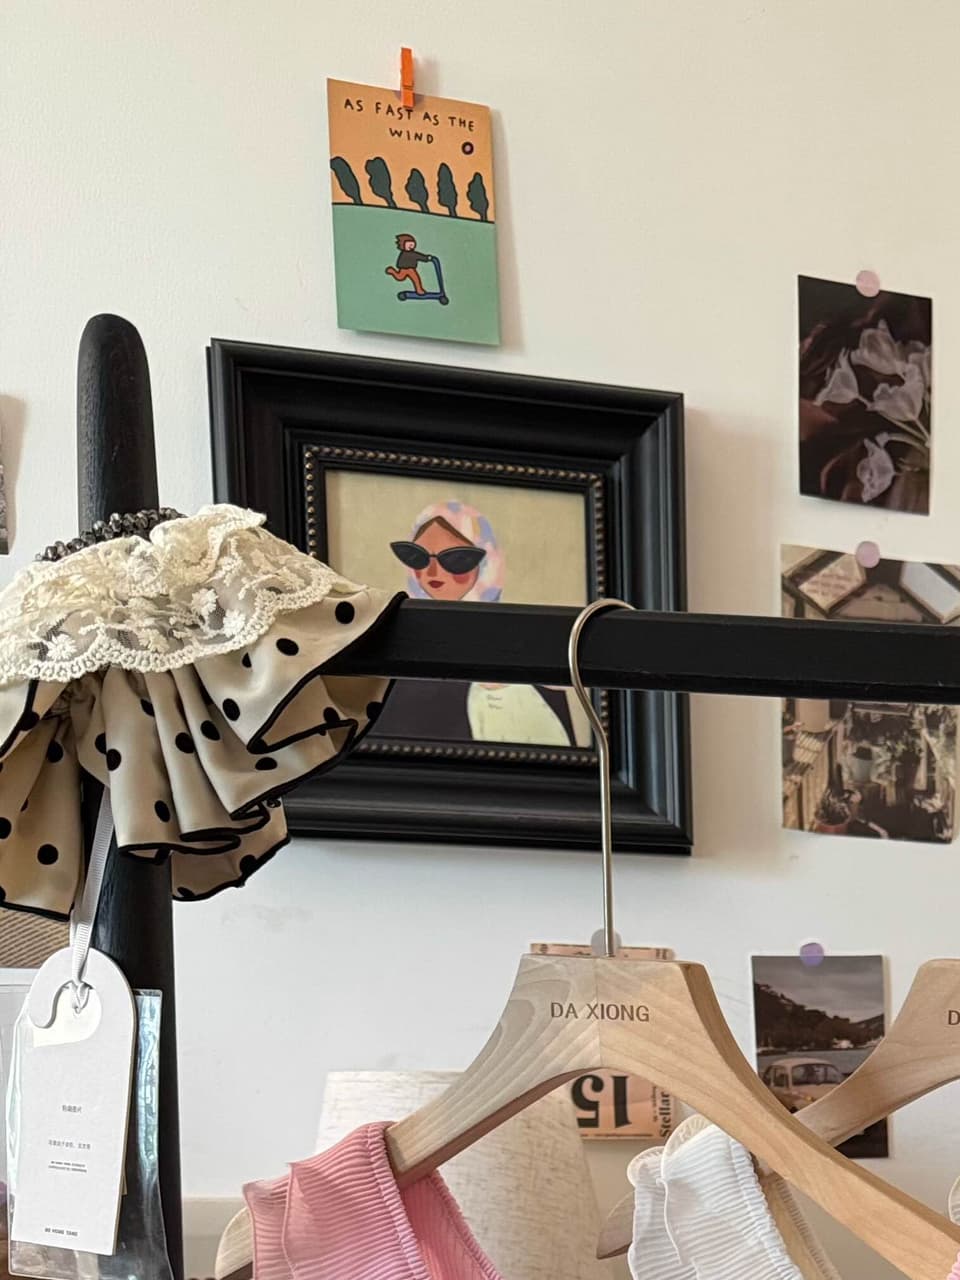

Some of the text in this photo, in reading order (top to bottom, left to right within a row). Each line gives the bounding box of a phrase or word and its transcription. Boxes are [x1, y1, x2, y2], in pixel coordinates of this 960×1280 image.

[344, 98, 475, 131] AS FAST AS THE
[389, 127, 434, 144] WIND
[551, 1002, 650, 1022] DA XIONG
[659, 1091, 672, 1138] Stellar
